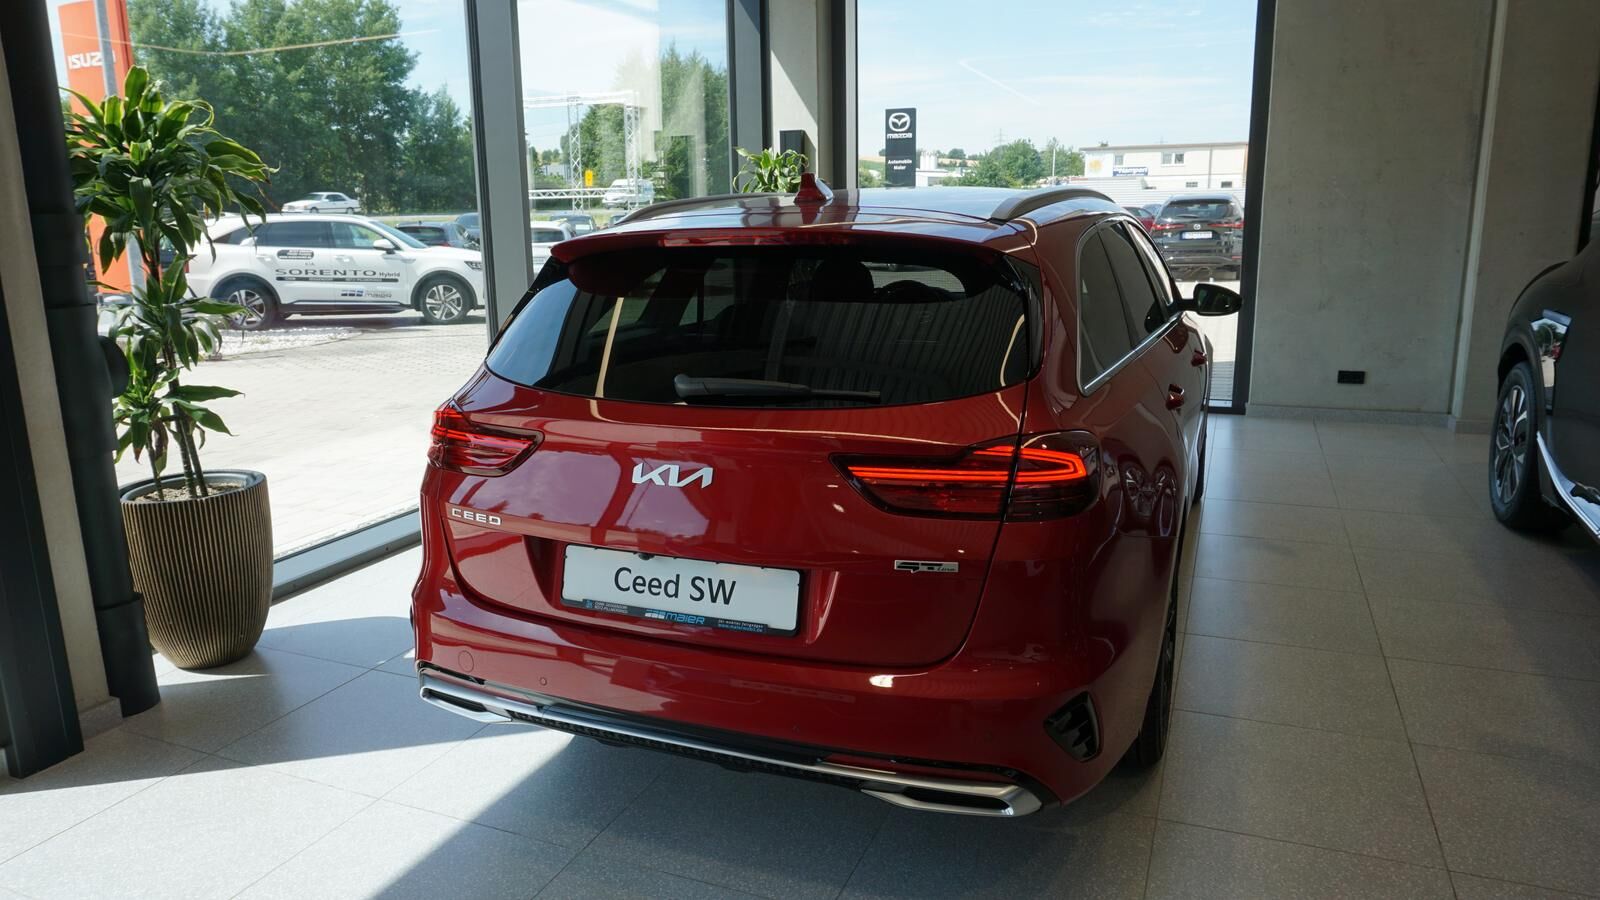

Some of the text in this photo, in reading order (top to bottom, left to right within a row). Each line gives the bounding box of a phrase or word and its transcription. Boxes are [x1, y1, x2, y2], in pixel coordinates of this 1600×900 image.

[67, 49, 116, 70] ISUZ
[887, 132, 912, 140] mazda
[275, 268, 377, 277] SORENTO
[631, 462, 713, 489] KIA
[451, 507, 502, 526] CEED
[613, 566, 737, 606] Ceed SW
